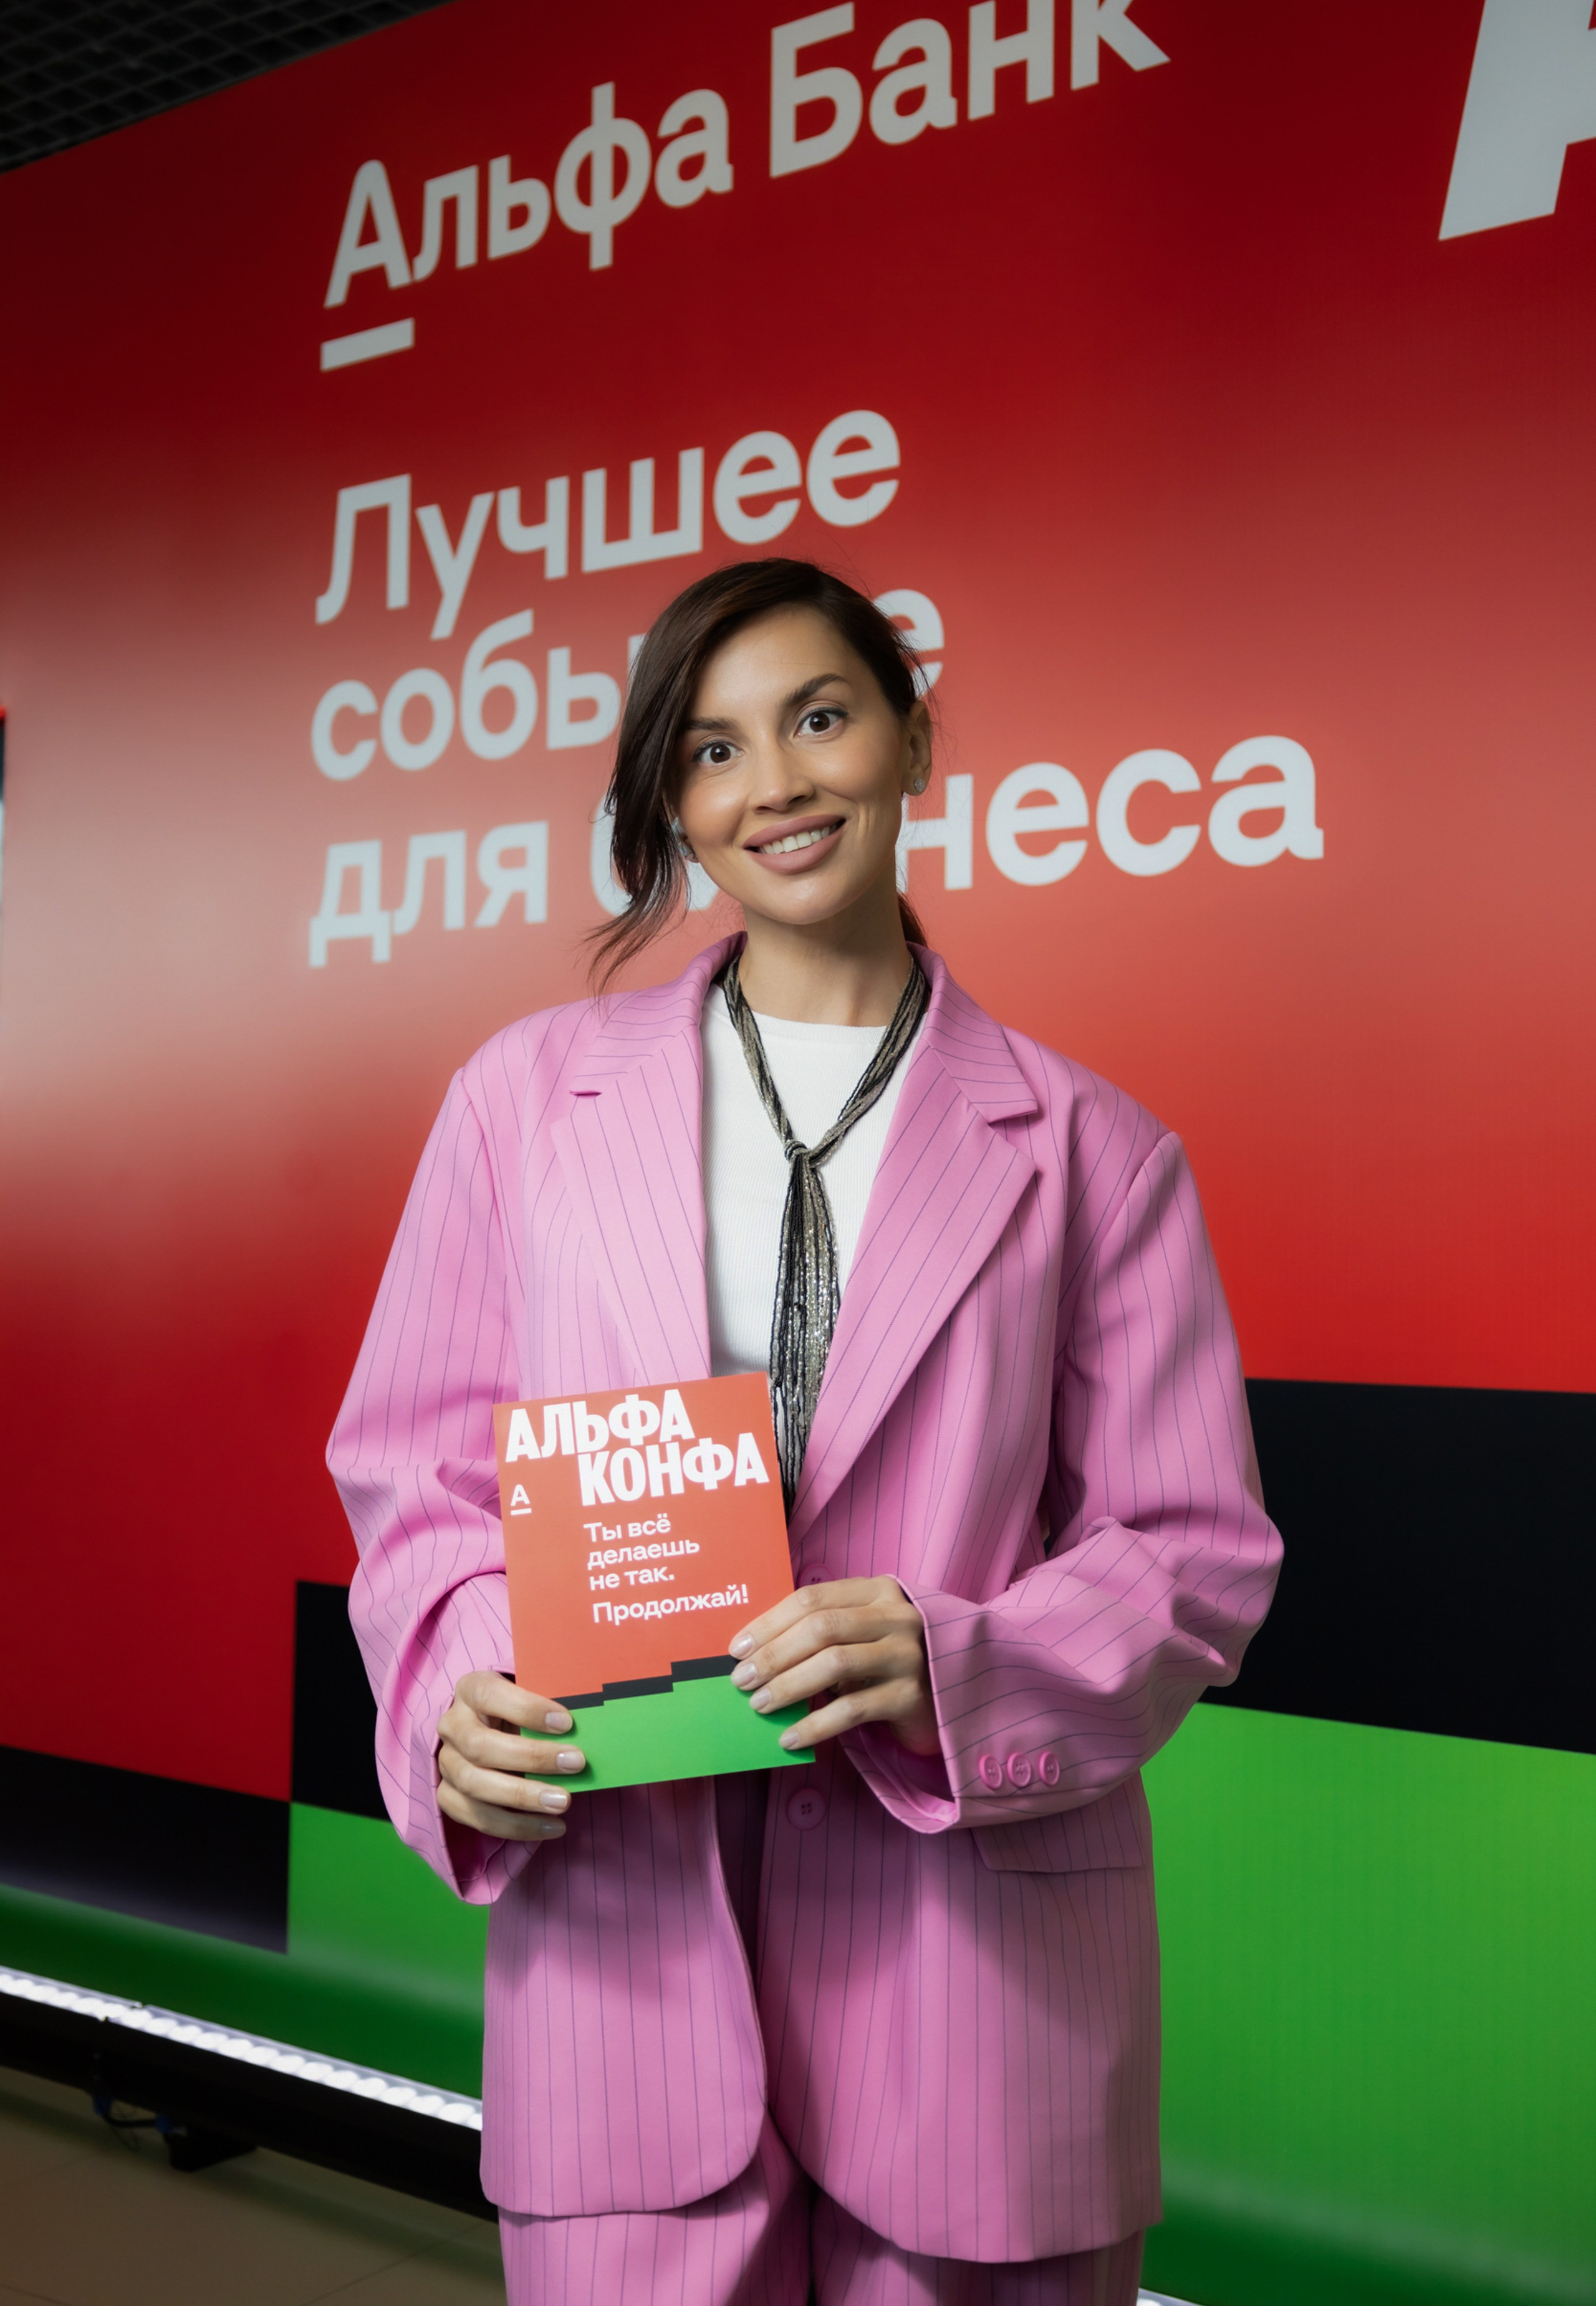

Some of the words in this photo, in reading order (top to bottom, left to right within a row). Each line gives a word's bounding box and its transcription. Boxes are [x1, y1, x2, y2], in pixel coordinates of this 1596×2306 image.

[324, 81, 734, 309] Альфа
[770, 0, 1171, 178] Банк
[315, 409, 901, 642] Лучшее
[312, 588, 945, 781] собые
[309, 820, 549, 969] для
[590, 734, 1325, 917] неса
[506, 1388, 696, 1463] АЛЬФА
[510, 1484, 530, 1506] А
[577, 1432, 771, 1506] КОНФА
[584, 1522, 622, 1543] Ты
[628, 1513, 672, 1536] всё
[587, 1539, 700, 1570] делаешь
[589, 1572, 620, 1590] не
[624, 1565, 675, 1586] так.
[592, 1584, 749, 1625] Продолжай!
